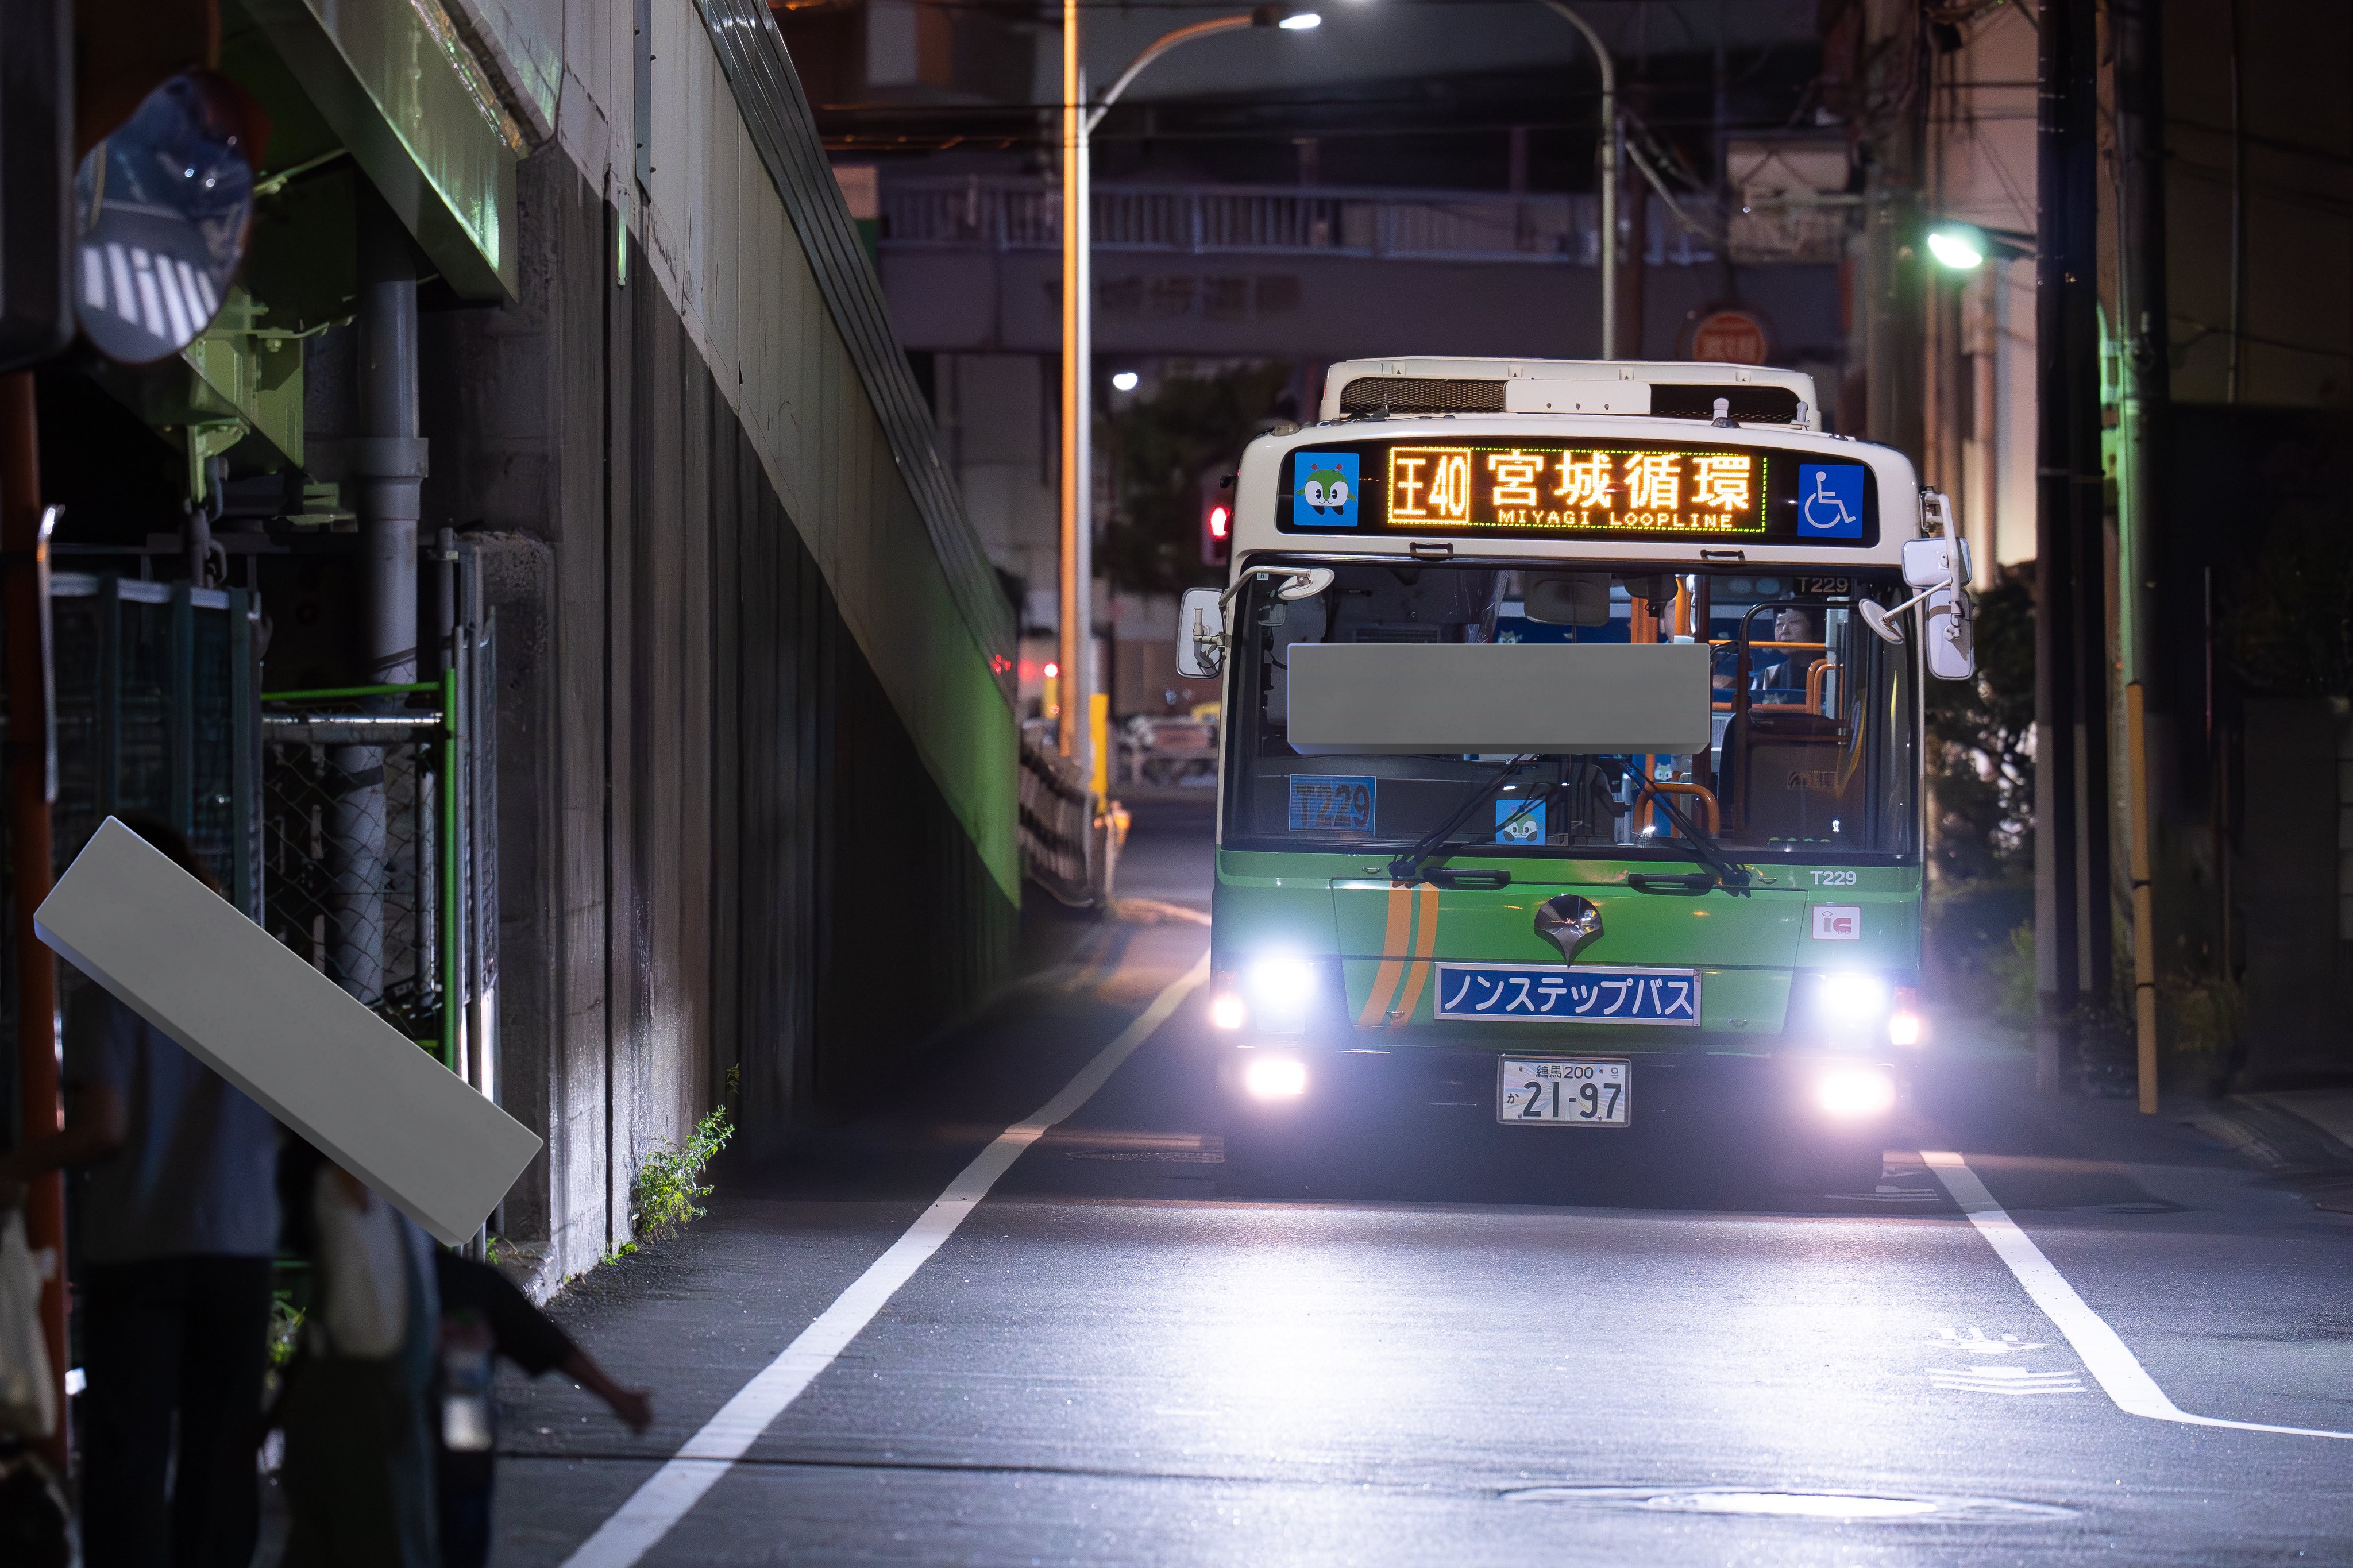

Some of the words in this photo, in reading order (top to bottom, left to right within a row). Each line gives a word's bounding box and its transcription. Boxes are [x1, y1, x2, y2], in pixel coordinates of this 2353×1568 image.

[1488, 450, 1750, 511] 宮城循環
[1499, 510, 1590, 524] MIYAGI
[1610, 512, 1732, 527] LOOPLINE
[1796, 577, 1848, 593] T229
[1295, 783, 1370, 827] T229
[1810, 871, 1856, 885] T229
[1444, 975, 1694, 1015] ノンステップバス
[1523, 1081, 1622, 1119] 21-97
